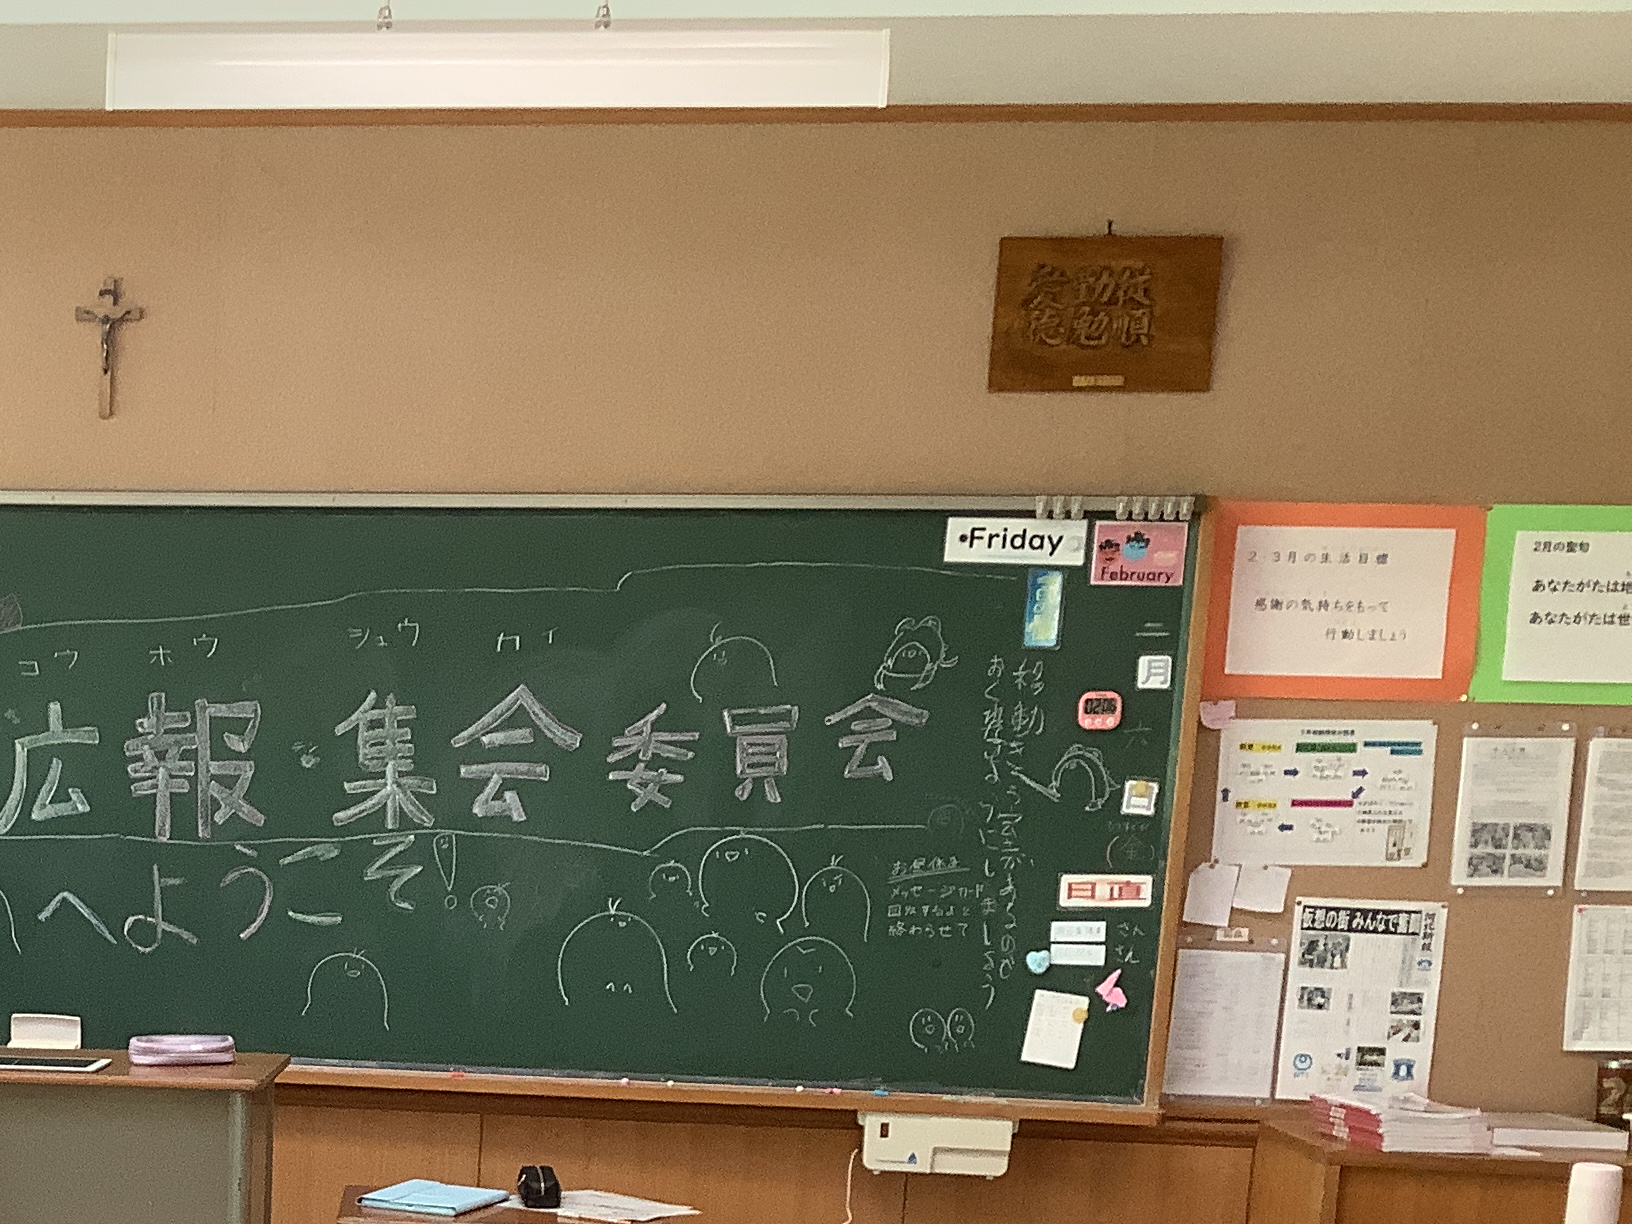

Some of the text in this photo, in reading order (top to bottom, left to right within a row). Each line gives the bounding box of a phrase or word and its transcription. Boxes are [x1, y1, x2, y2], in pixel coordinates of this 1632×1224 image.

[968, 526, 1065, 557] Friday
[1100, 567, 1175, 583] February
[1254, 598, 1389, 614] 感謝の気持ちをもって
[1325, 628, 1407, 642] 行動しましょう
[1140, 658, 1169, 685] 月
[1067, 880, 1147, 901] 日直
